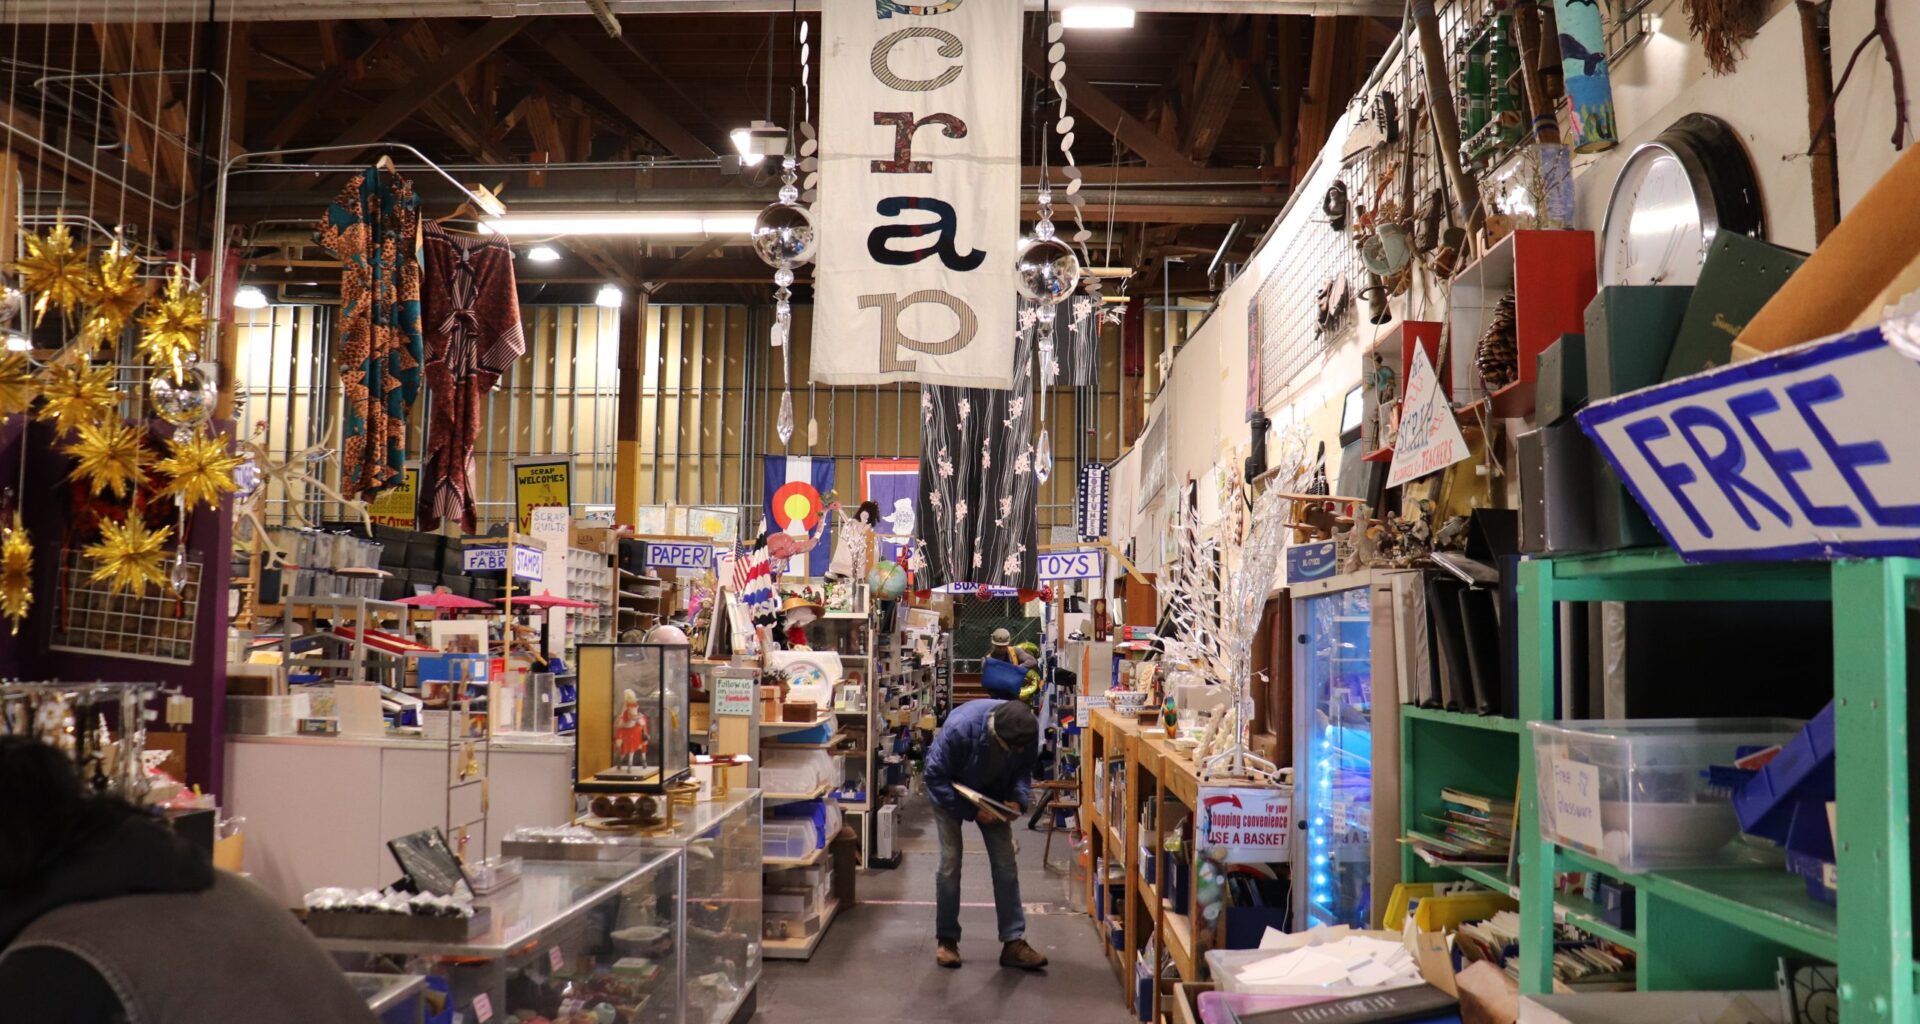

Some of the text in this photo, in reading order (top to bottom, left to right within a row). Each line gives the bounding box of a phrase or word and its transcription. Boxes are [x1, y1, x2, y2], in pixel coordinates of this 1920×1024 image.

[857, 0, 986, 373] crap
[1623, 374, 1920, 539] FREE
[519, 474, 565, 485] WELCOMES
[1088, 469, 1098, 536] COSTUMES
[534, 512, 566, 521] SCRAP
[534, 522, 566, 532] QUILTS
[517, 551, 540, 575] STAMPS
[1038, 555, 1089, 575] TOYS
[717, 680, 740, 689] Follow
[1265, 803, 1288, 815] For your
[1211, 812, 1288, 829] hopping convenience
[1232, 833, 1241, 845] A
[1243, 833, 1287, 846] BASKET
